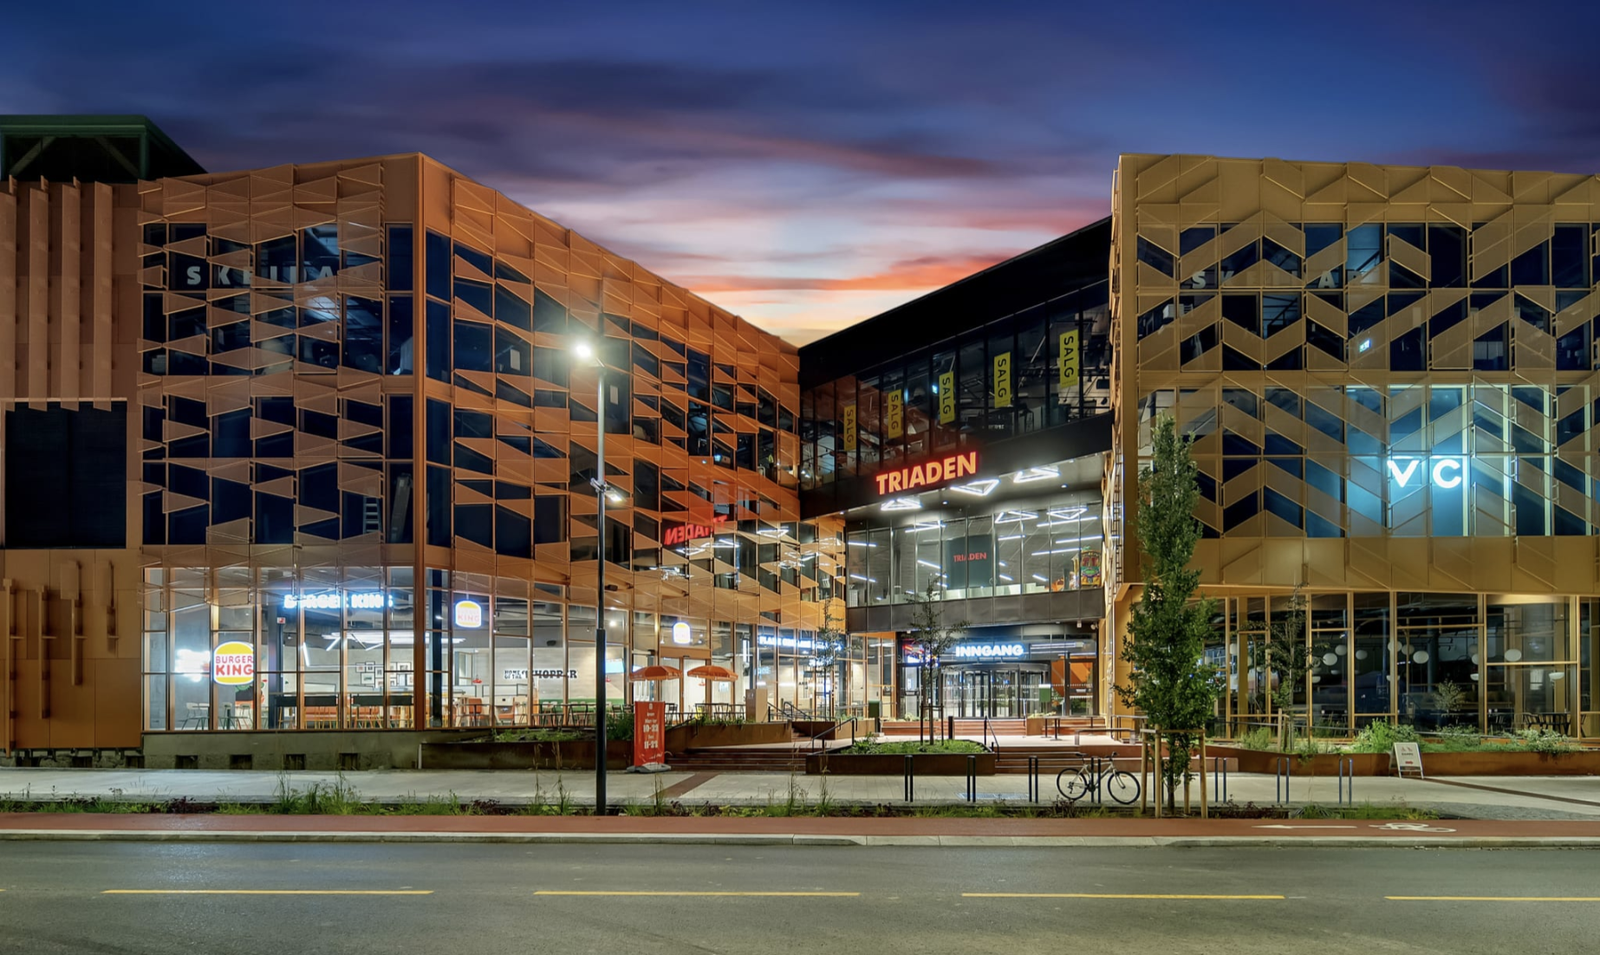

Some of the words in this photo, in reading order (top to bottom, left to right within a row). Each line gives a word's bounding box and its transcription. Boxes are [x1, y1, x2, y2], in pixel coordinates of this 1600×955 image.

[1062, 335, 1076, 379] SALG
[942, 376, 952, 415] SALG
[997, 358, 1008, 399] SALG
[846, 408, 854, 444] SALG
[890, 393, 899, 430] SALG
[876, 453, 977, 496] TRIADEN
[215, 655, 254, 664] BURGER
[955, 644, 1024, 657] INNGANG
[215, 664, 254, 676] KING
